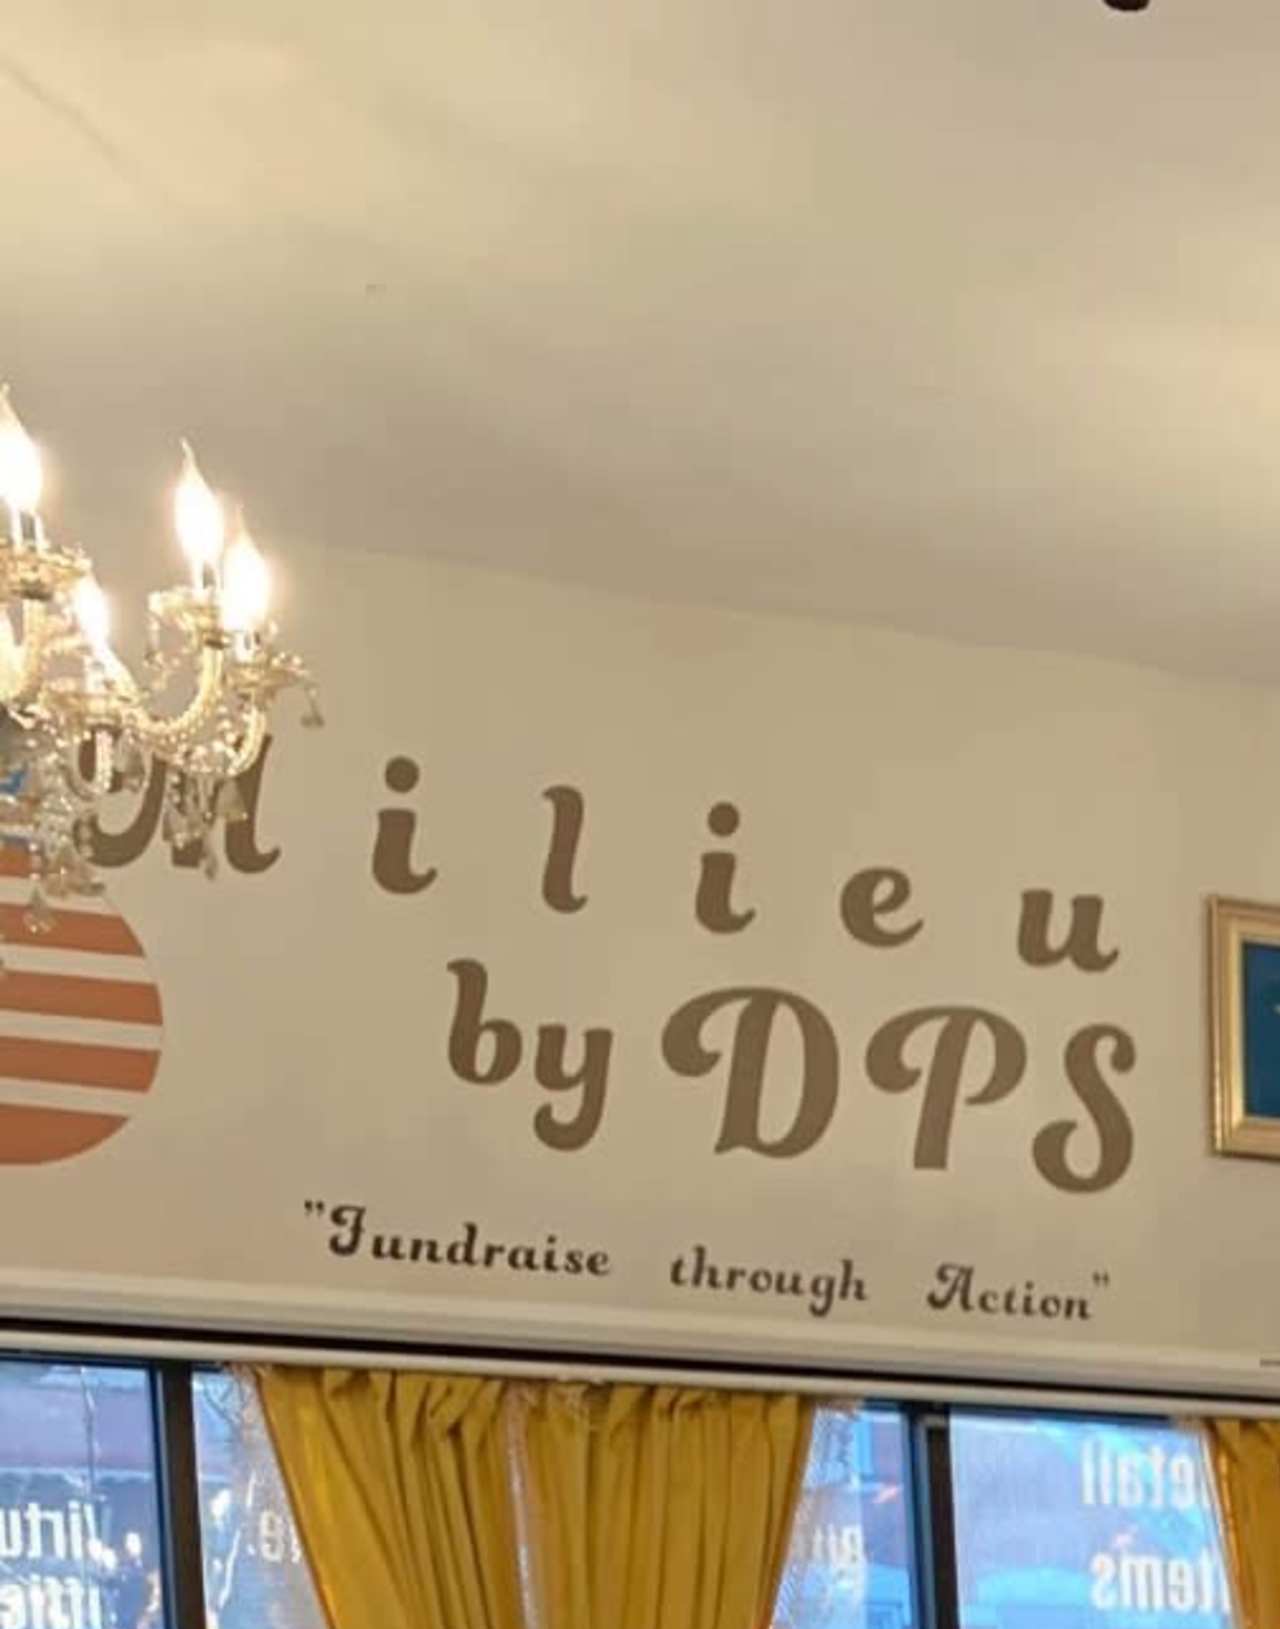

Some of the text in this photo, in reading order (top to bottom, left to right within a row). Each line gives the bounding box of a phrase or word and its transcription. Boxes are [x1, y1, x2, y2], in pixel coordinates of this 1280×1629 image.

[446, 957, 1137, 1193] by DPS
[669, 1245, 868, 1317] through
